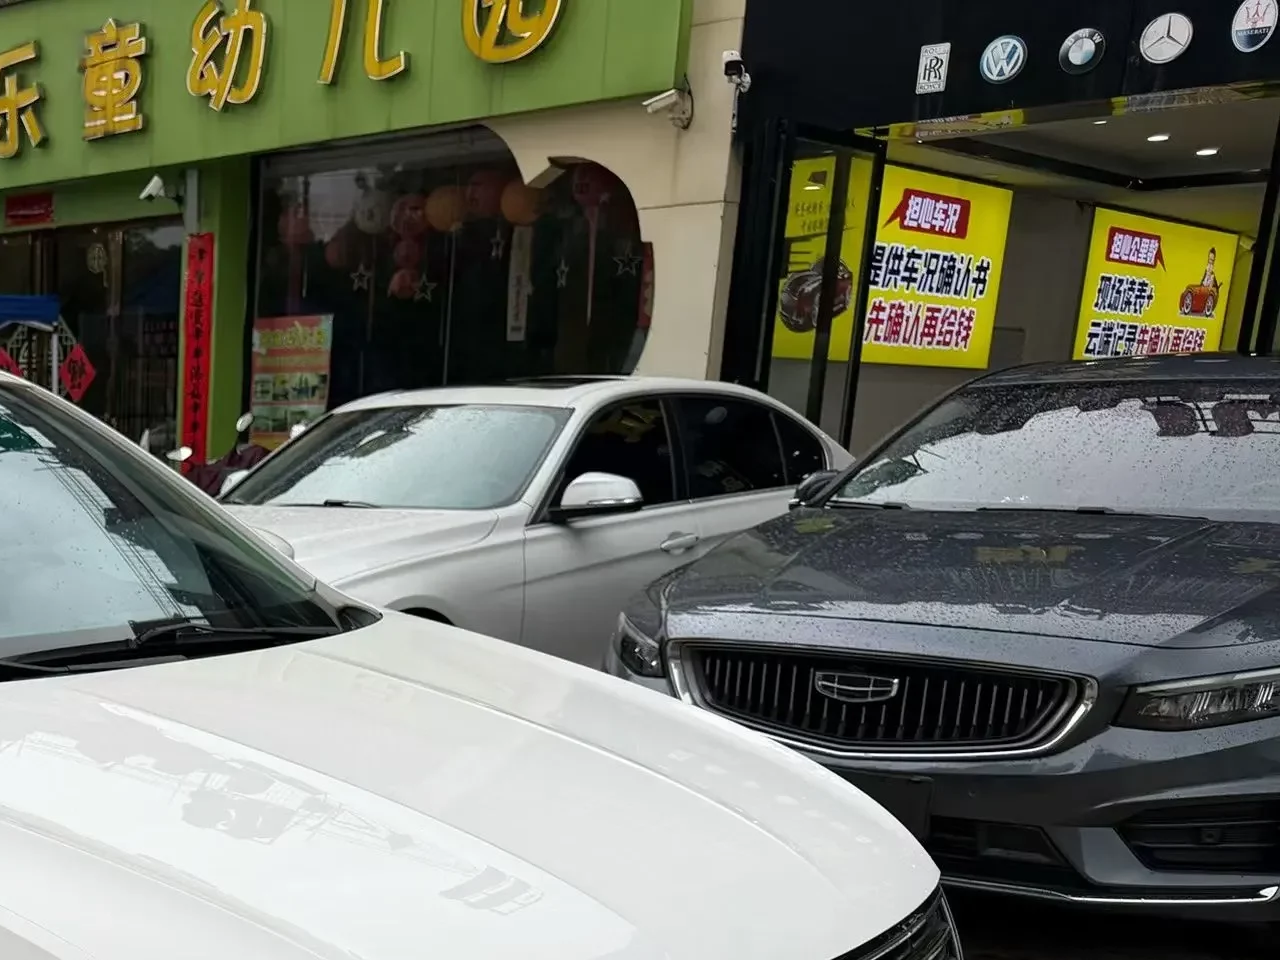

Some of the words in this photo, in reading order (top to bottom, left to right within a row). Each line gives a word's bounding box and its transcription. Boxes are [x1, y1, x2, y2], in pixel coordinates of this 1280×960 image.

[904, 195, 961, 233] 担心车况
[1093, 275, 1154, 315] 现场读表+
[864, 301, 975, 351] 先确认再给钱
